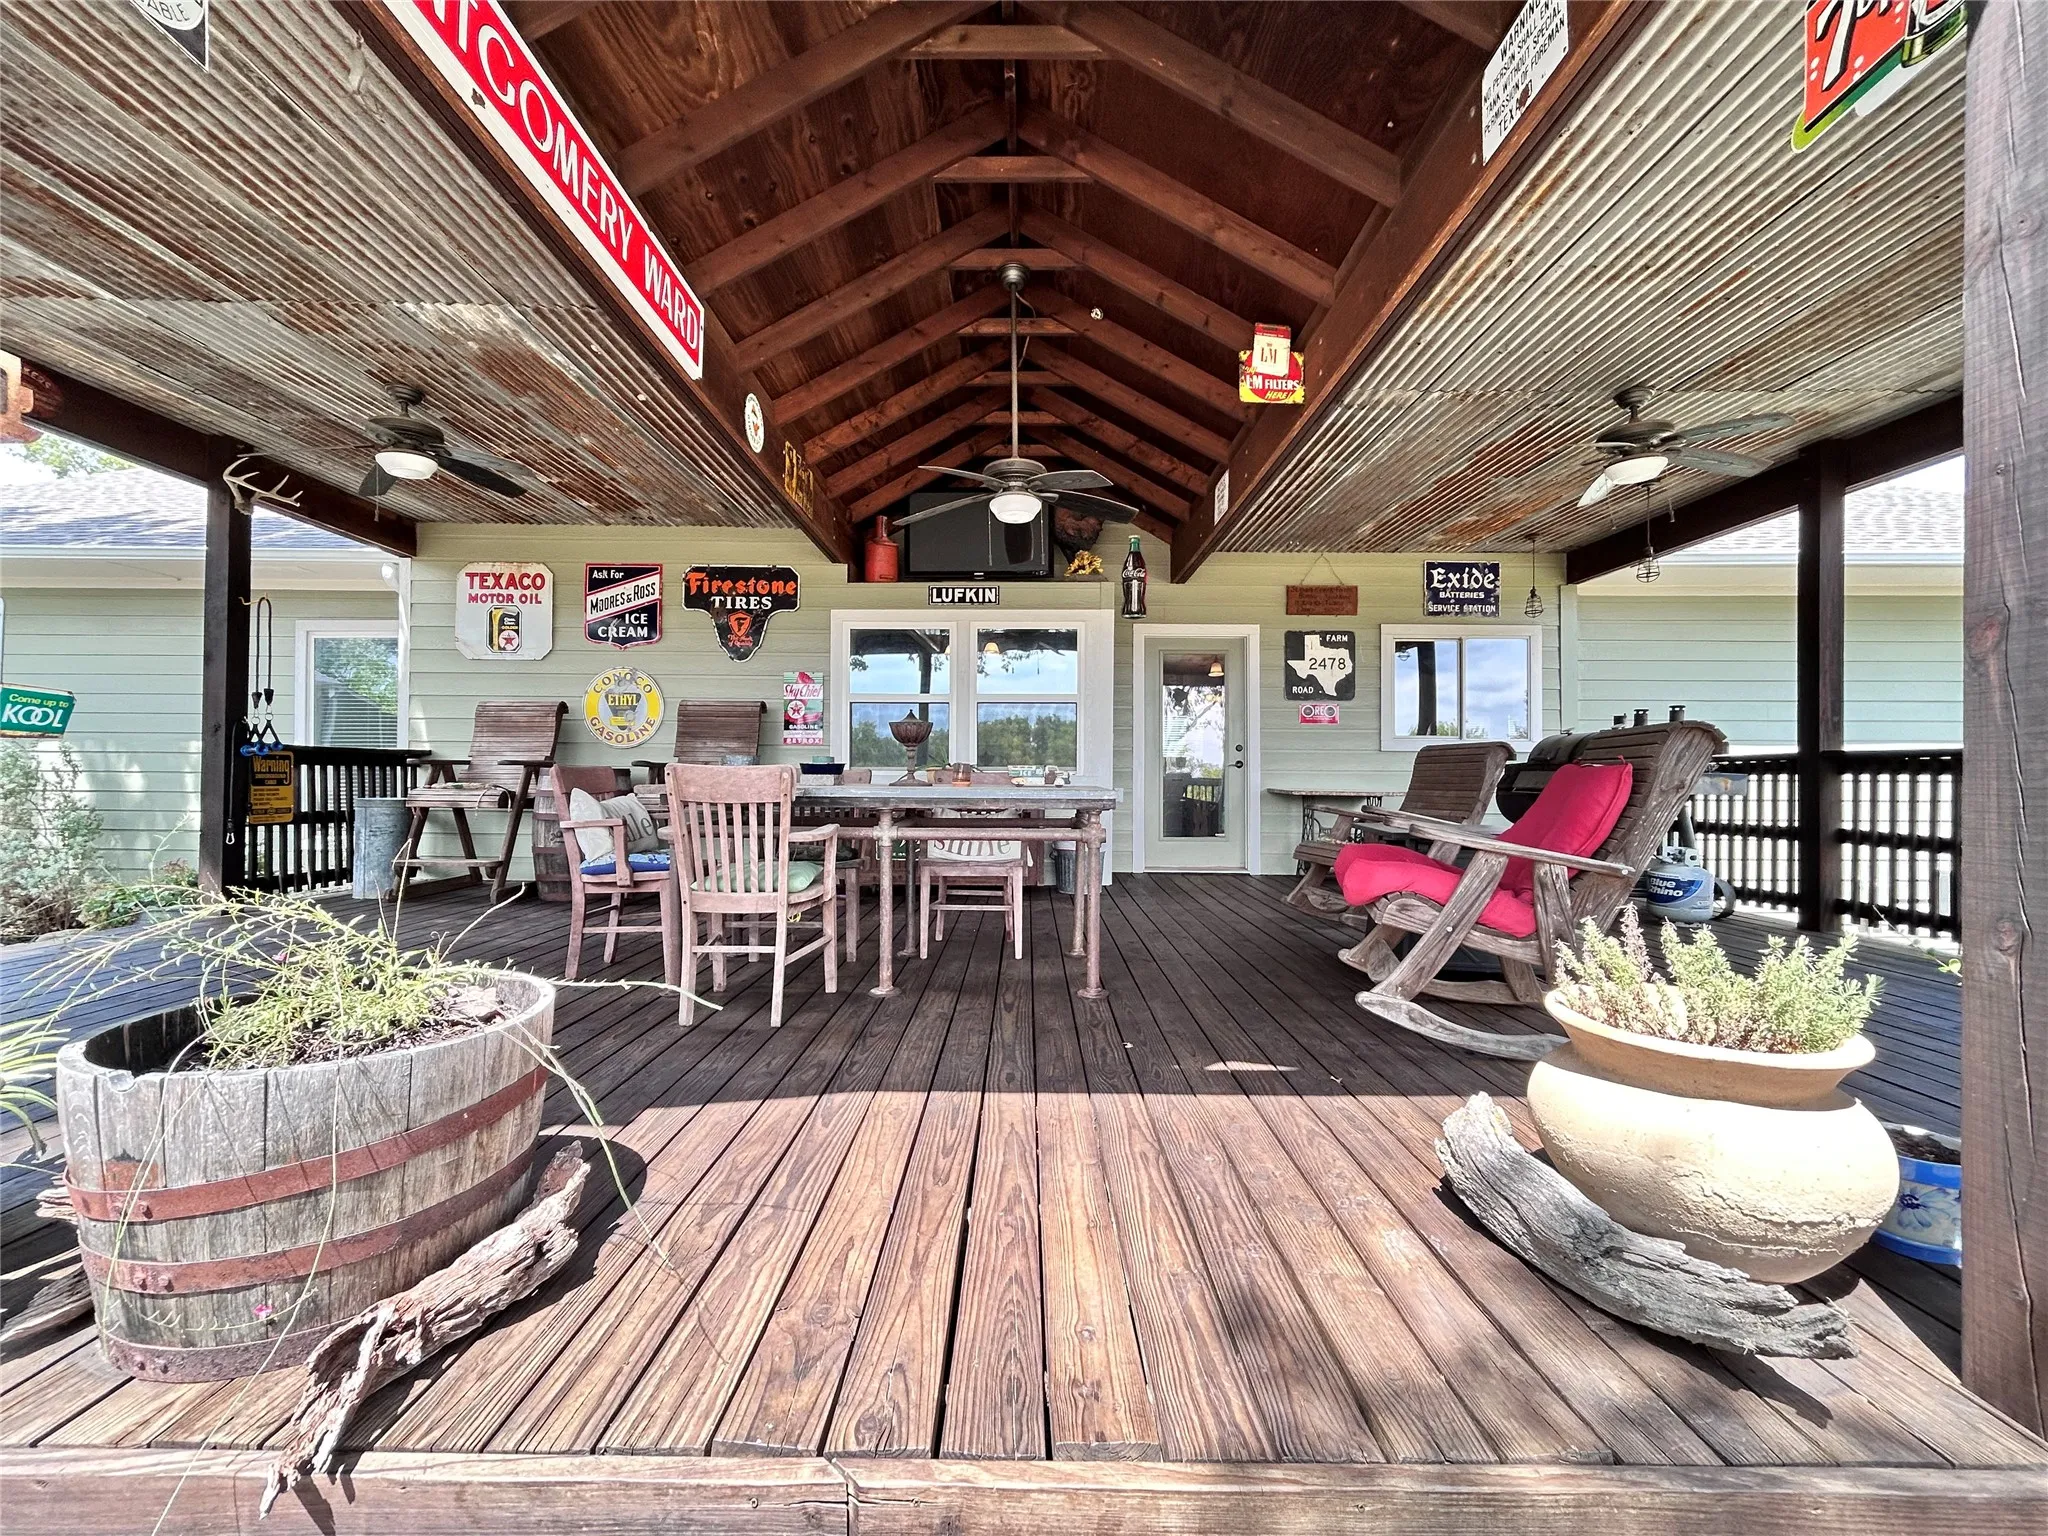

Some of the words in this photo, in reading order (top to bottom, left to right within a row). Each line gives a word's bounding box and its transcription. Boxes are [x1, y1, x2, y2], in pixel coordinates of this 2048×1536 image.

[140, 0, 190, 21] ABLE
[1492, 52, 1515, 90] PERSON
[1517, 20, 1537, 54] SHALL
[1502, 46, 1530, 94] WITHOUT
[1533, 2, 1562, 50] SPECIAL
[1484, 79, 1520, 137] PERMISSION
[1521, 67, 1530, 86] OF
[1531, 13, 1565, 71] FOREMAN
[644, 243, 699, 350] WARD
[1265, 378, 1299, 390] FILTERS
[465, 572, 545, 591] TEXACO
[592, 570, 608, 579] Ask
[610, 570, 624, 579] For
[1430, 567, 1495, 589] Exide
[686, 572, 797, 595] Firestone
[468, 593, 514, 604] MOTOR
[519, 593, 542, 604] OIL
[590, 592, 625, 614] MOORES
[633, 582, 656, 601] ROSS
[932, 588, 996, 602] LUFKIN
[711, 596, 772, 609] TIRES
[1428, 604, 1460, 612] SERVICE
[1463, 604, 1496, 612] STATION
[625, 613, 648, 624] ICE
[598, 626, 648, 638] CREAM
[1326, 634, 1348, 642] FARM
[1309, 657, 1346, 670] 2478
[593, 672, 652, 693] CONOCO
[785, 684, 799, 699] Sky
[800, 684, 823, 697] Chief
[1292, 686, 1314, 694] ROAD
[9, 693, 41, 704] Come
[43, 699, 56, 707] up
[608, 694, 637, 706] ETHYL
[1, 703, 63, 727] KOOL
[1301, 705, 1337, 718] OREO
[590, 717, 656, 743] GASOLINE
[253, 755, 289, 784] Warning
[1650, 878, 1676, 888] Blue
